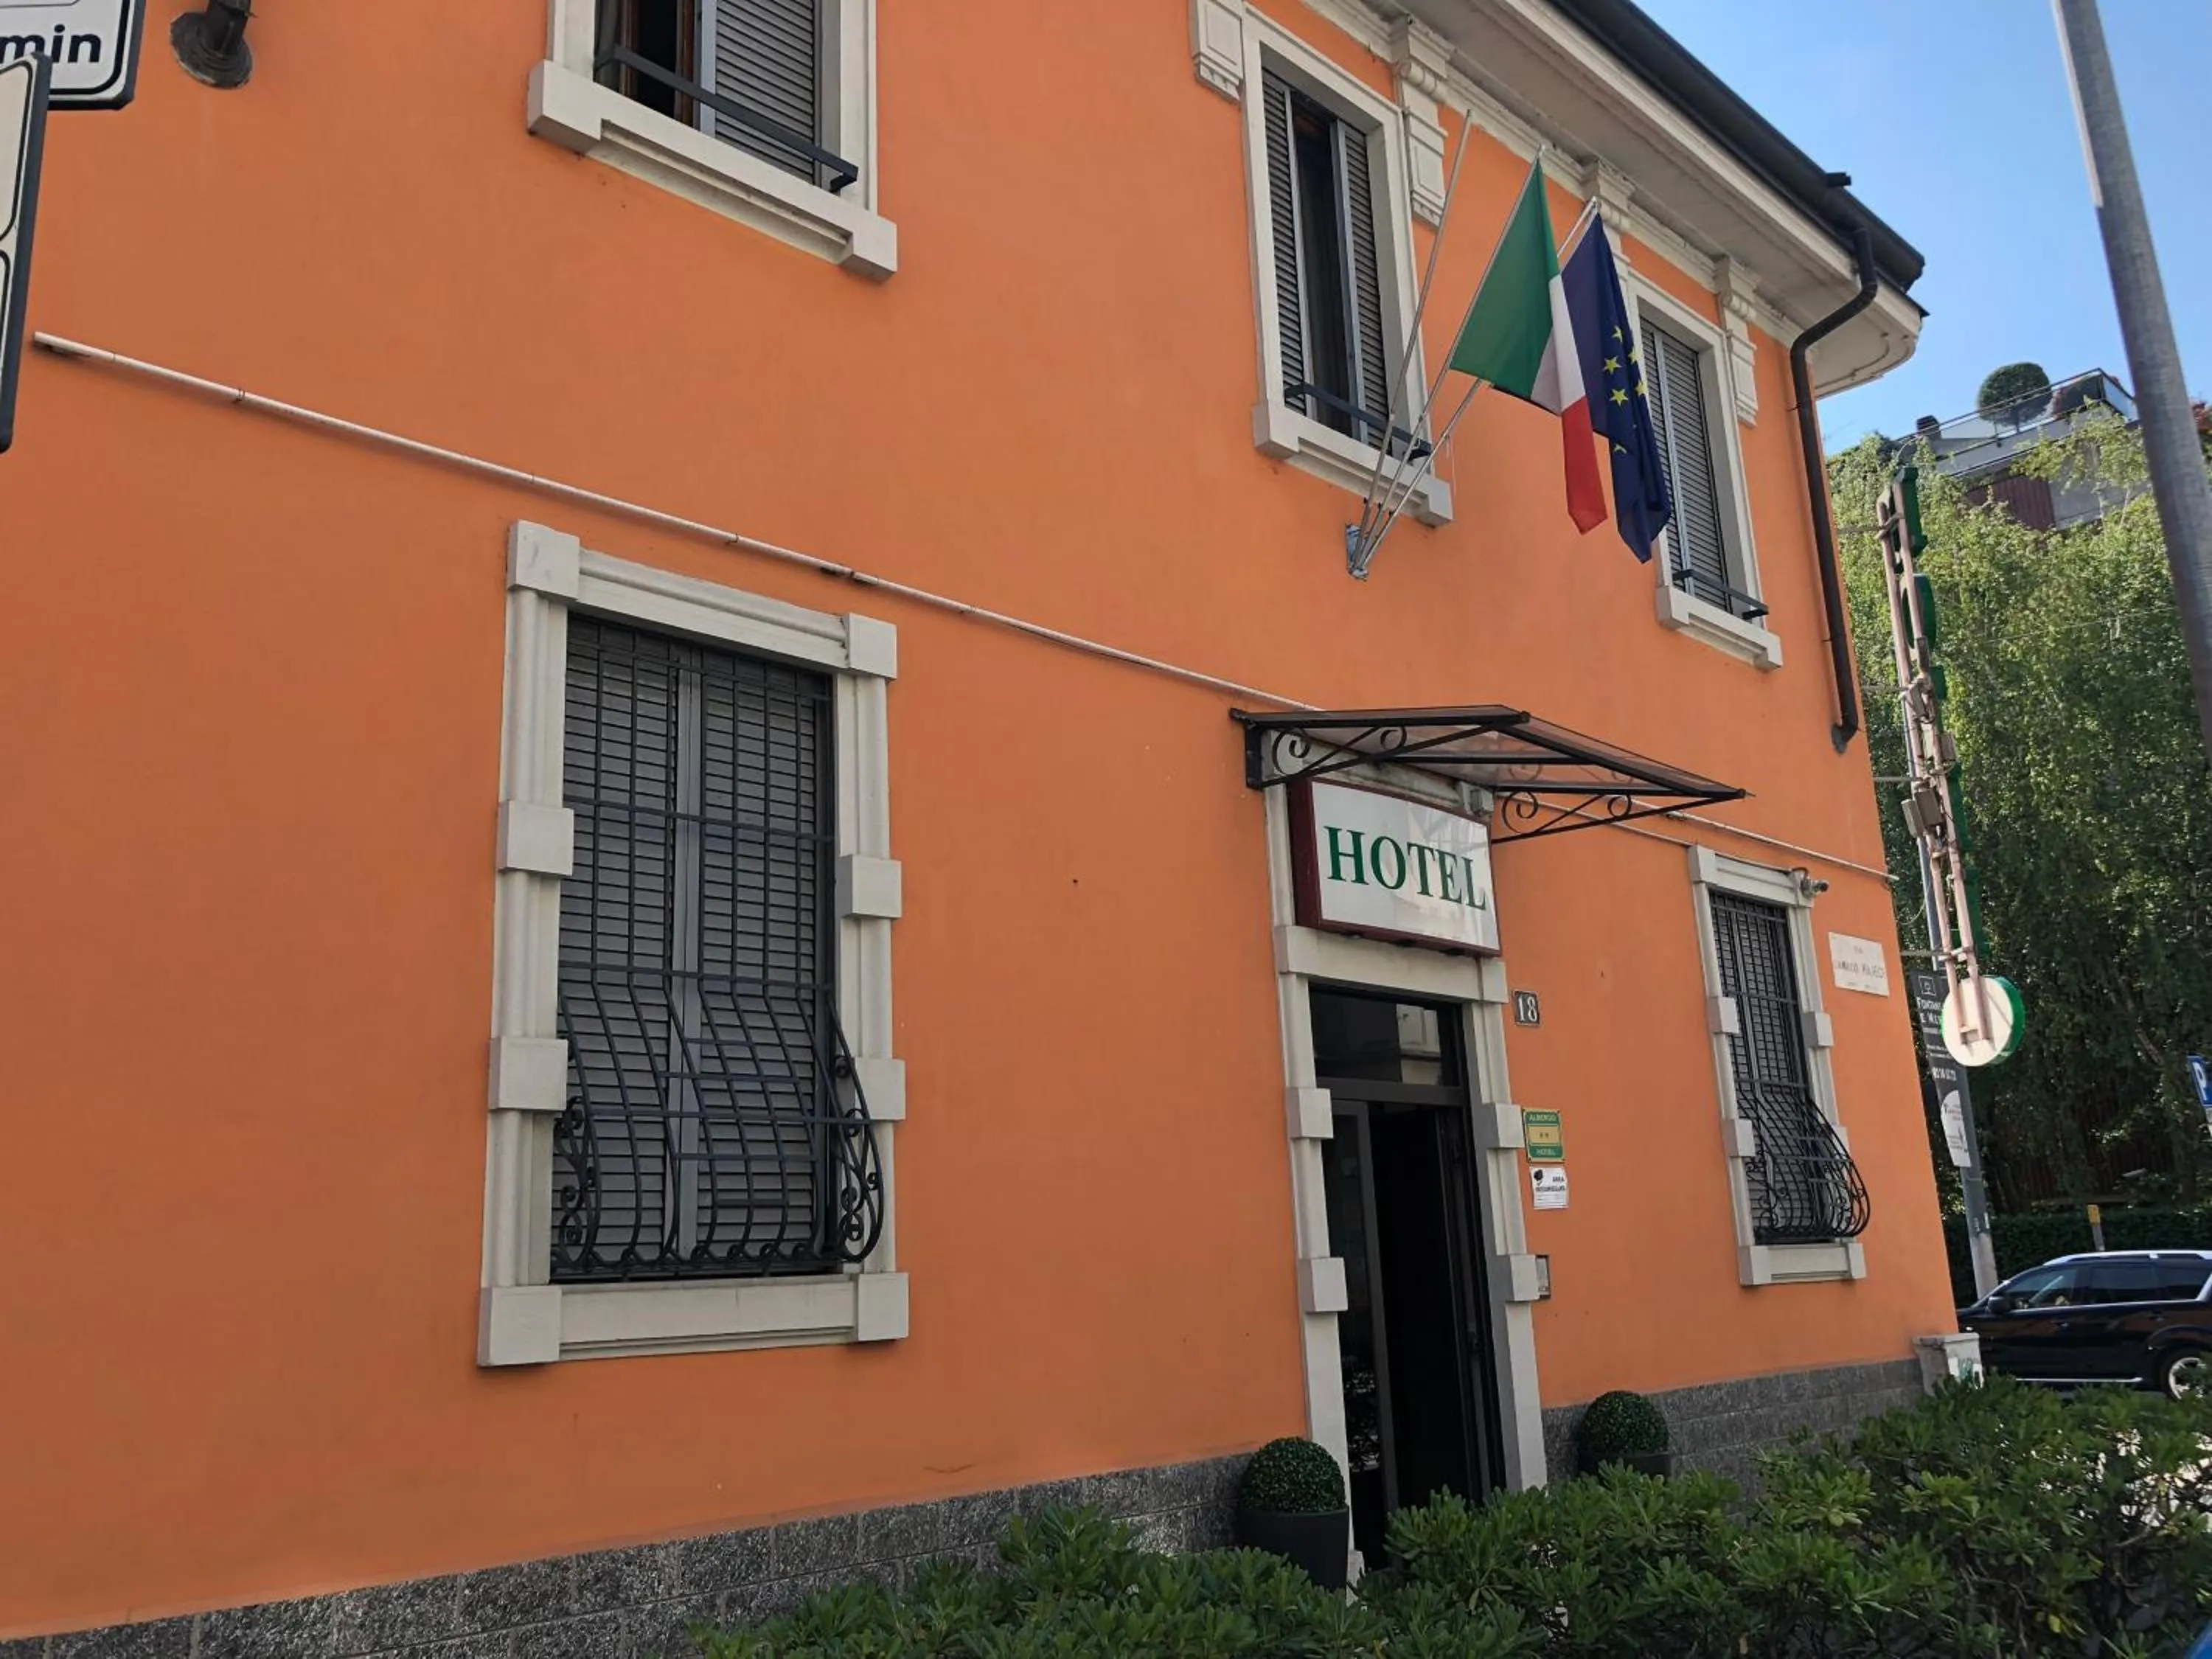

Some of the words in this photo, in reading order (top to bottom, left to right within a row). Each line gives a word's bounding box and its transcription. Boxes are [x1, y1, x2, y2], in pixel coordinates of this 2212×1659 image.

[0, 24, 101, 63] min
[1324, 825, 1486, 911] HOTEL
[1519, 995, 1537, 1022] 18
[2192, 1062, 2208, 1101] P
